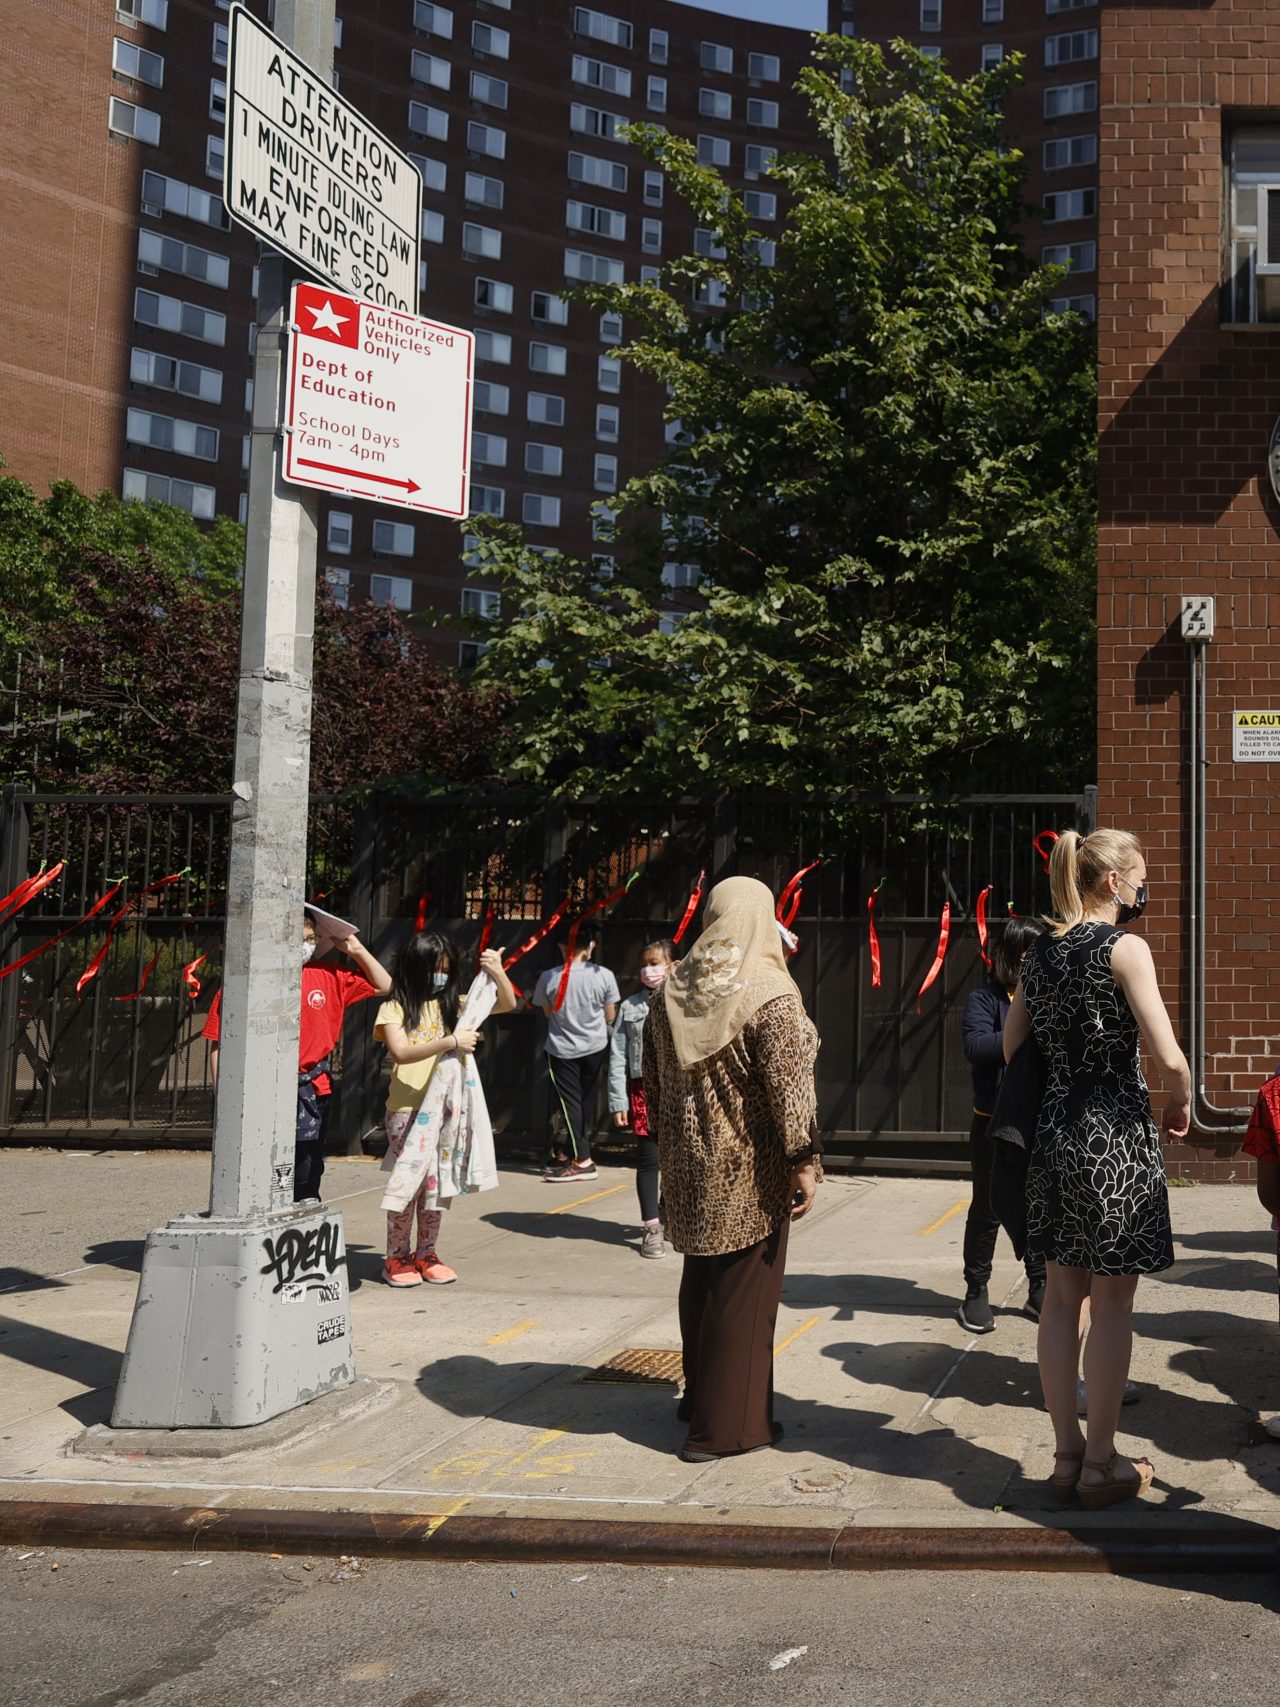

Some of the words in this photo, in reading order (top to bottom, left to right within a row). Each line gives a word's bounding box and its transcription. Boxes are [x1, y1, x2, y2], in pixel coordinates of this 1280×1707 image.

[267, 54, 396, 185] ATTENTION
[282, 97, 383, 203] DRIVERS
[242, 108, 248, 137] 1
[258, 121, 319, 193] MINUTE
[327, 177, 374, 237] IDLING
[382, 221, 410, 266] LAW
[240, 179, 287, 238] MAX
[299, 222, 341, 277] FINE
[269, 165, 389, 278] ENFORCED
[365, 311, 454, 348] Authorized
[365, 326, 431, 356] Vehicles
[302, 352, 348, 378] Dept
[355, 370, 373, 384] of
[364, 341, 400, 364] Only
[301, 375, 396, 412] Education
[298, 411, 355, 438] School
[362, 427, 400, 449] Days
[298, 430, 332, 450] 7am
[350, 443, 385, 463] 4pm
[318, 1315, 345, 1331] CRUDE
[318, 1325, 345, 1341] TAPES
